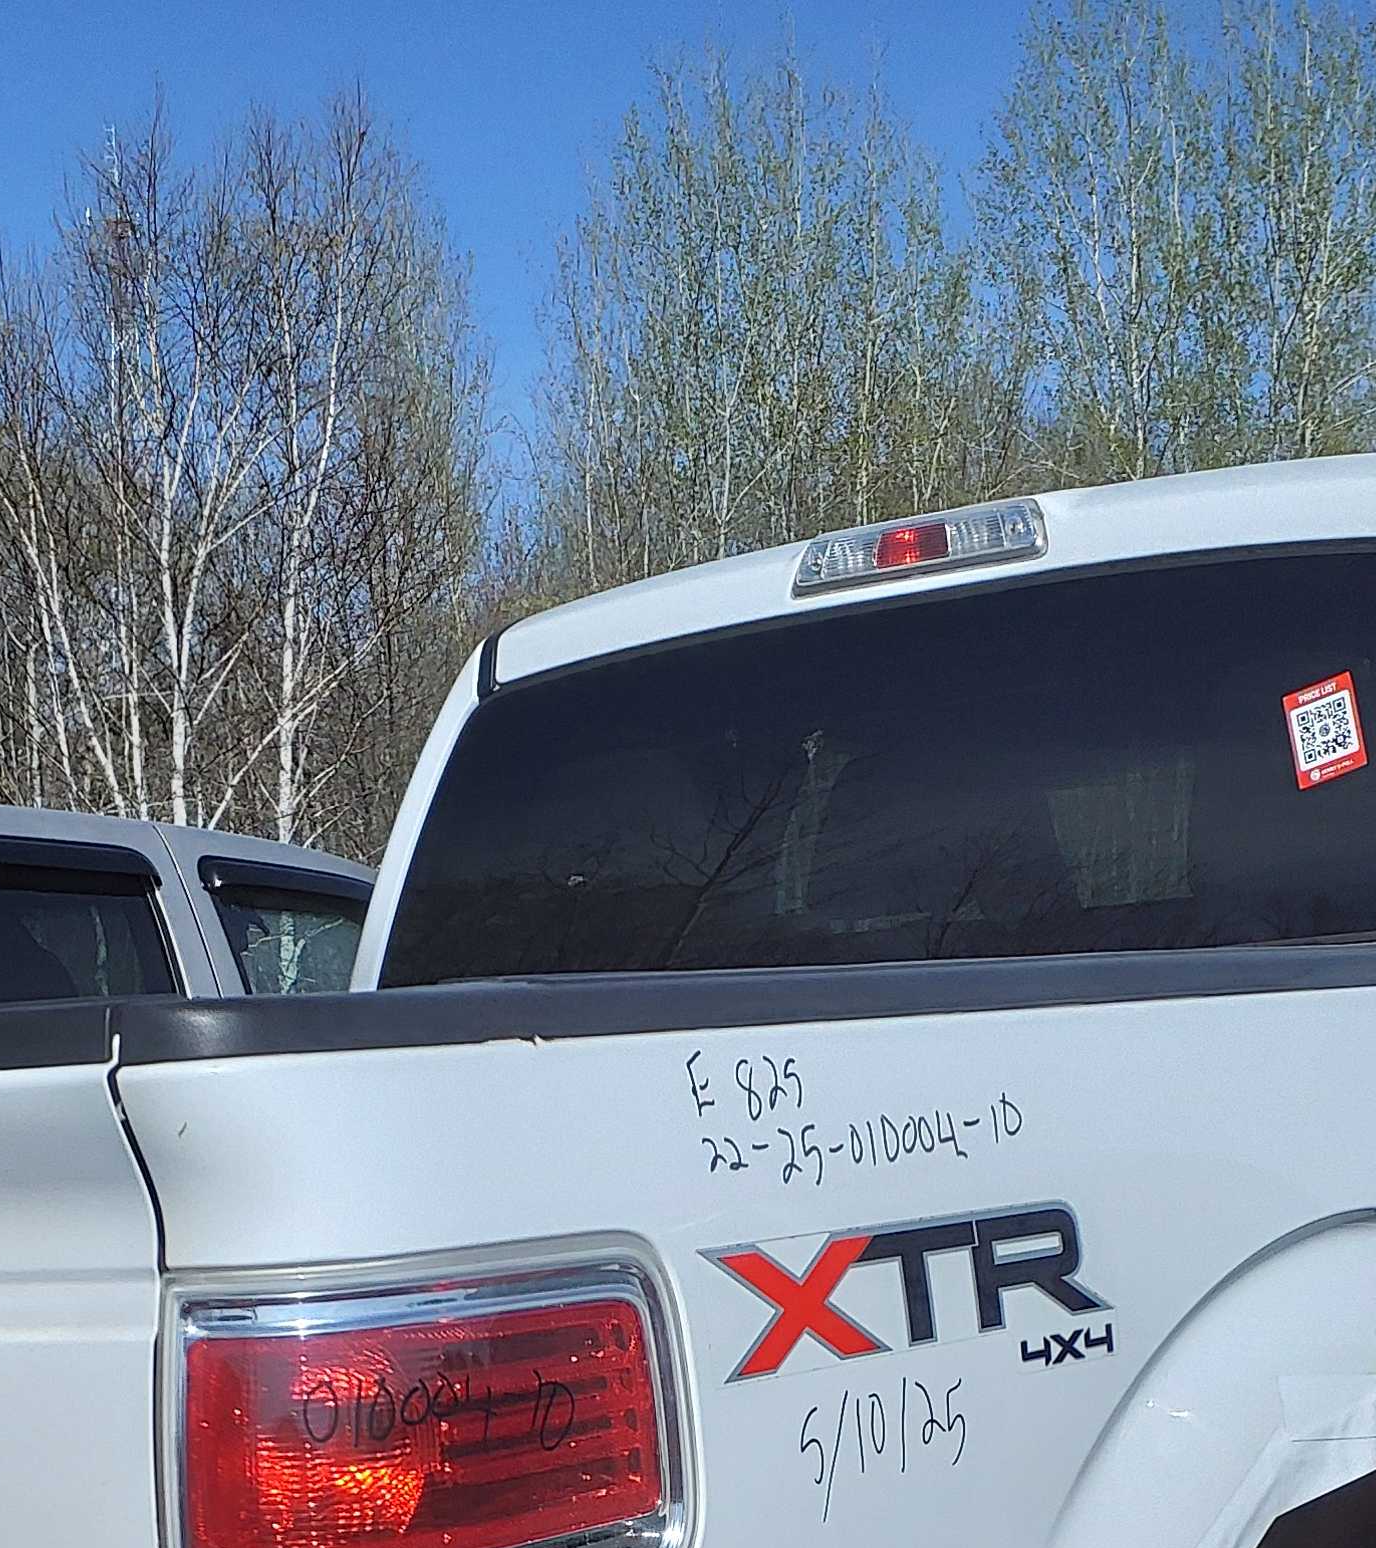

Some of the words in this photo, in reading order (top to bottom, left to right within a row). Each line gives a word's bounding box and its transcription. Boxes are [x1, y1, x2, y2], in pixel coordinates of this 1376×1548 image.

[686, 1050, 715, 1117] E
[735, 1056, 804, 1121] 825
[701, 1092, 1023, 1186] 22-25-010004-10
[697, 1199, 1114, 1384] XTR
[799, 1376, 967, 1523] 5/10/25
